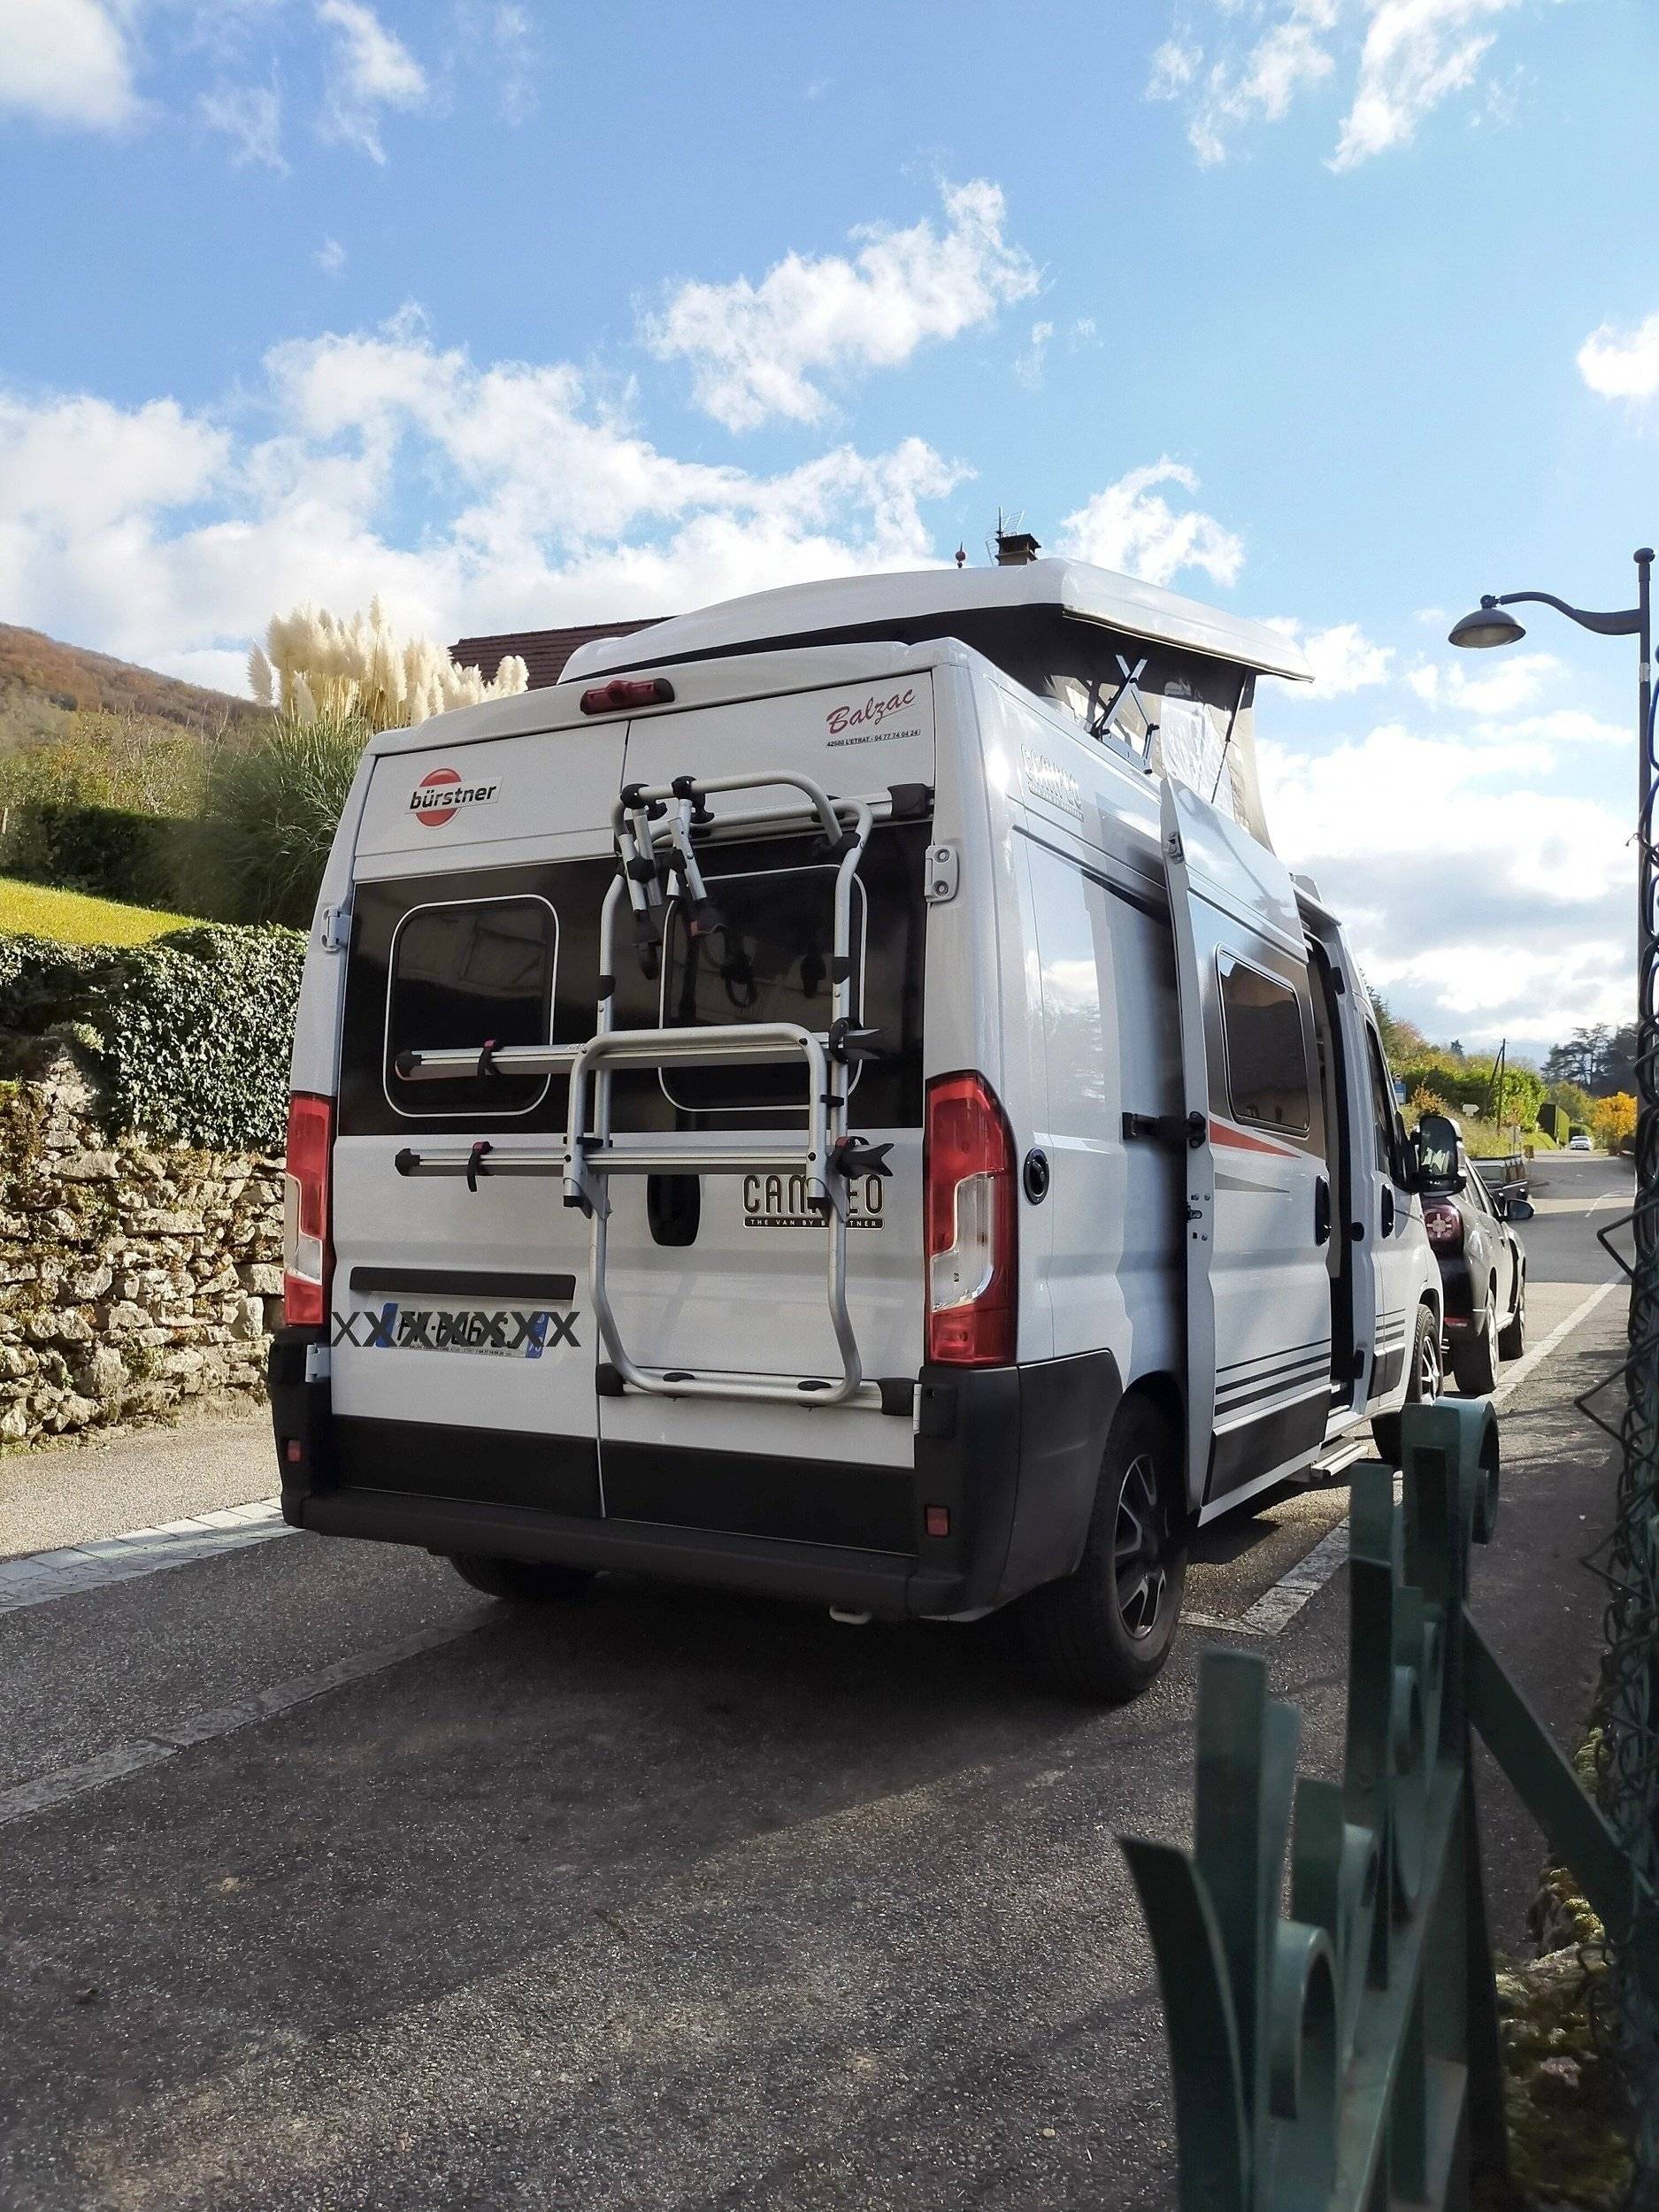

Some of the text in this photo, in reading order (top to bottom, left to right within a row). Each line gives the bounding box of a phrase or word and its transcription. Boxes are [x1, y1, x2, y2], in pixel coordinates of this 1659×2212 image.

[826, 689, 916, 733] Balzac
[410, 785, 497, 810] bürstner
[743, 1174, 883, 1214] CAMEO
